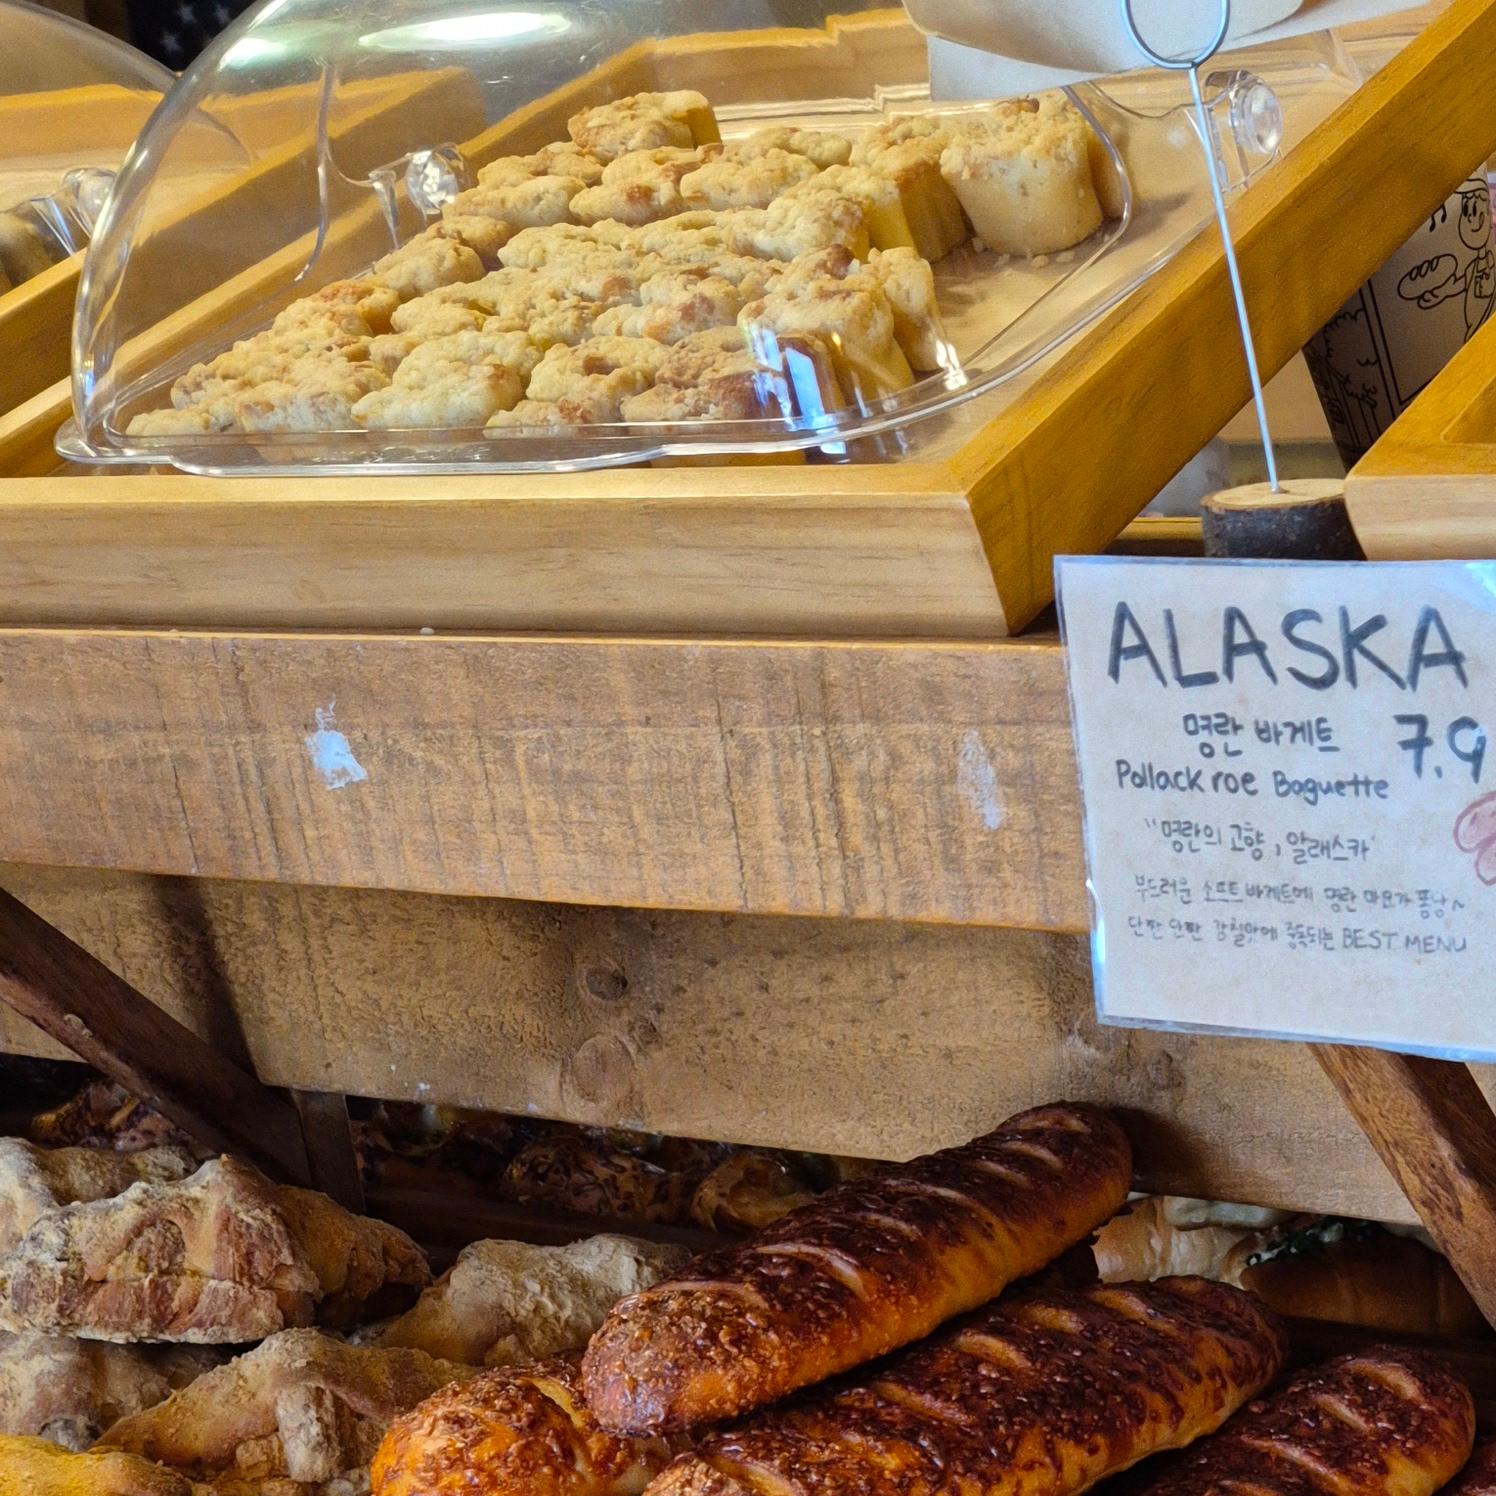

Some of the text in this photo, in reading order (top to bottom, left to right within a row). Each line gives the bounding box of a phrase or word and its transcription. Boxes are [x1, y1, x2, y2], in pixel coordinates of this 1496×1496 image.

[1107, 601, 1469, 692] ALASKA
[1182, 711, 1341, 759] 명란 바게트
[1392, 713, 1488, 784] 7.9
[1115, 759, 1205, 794] Pollack
[1211, 772, 1259, 797] roe
[1135, 873, 1192, 905] 부드러운
[1202, 880, 1244, 903] 소프트
[1245, 882, 1314, 904] 바게트에
[1323, 886, 1358, 913] 명란
[1362, 889, 1413, 910] 마요가
[1342, 927, 1398, 950] BEST
[1405, 934, 1467, 954] MENU
